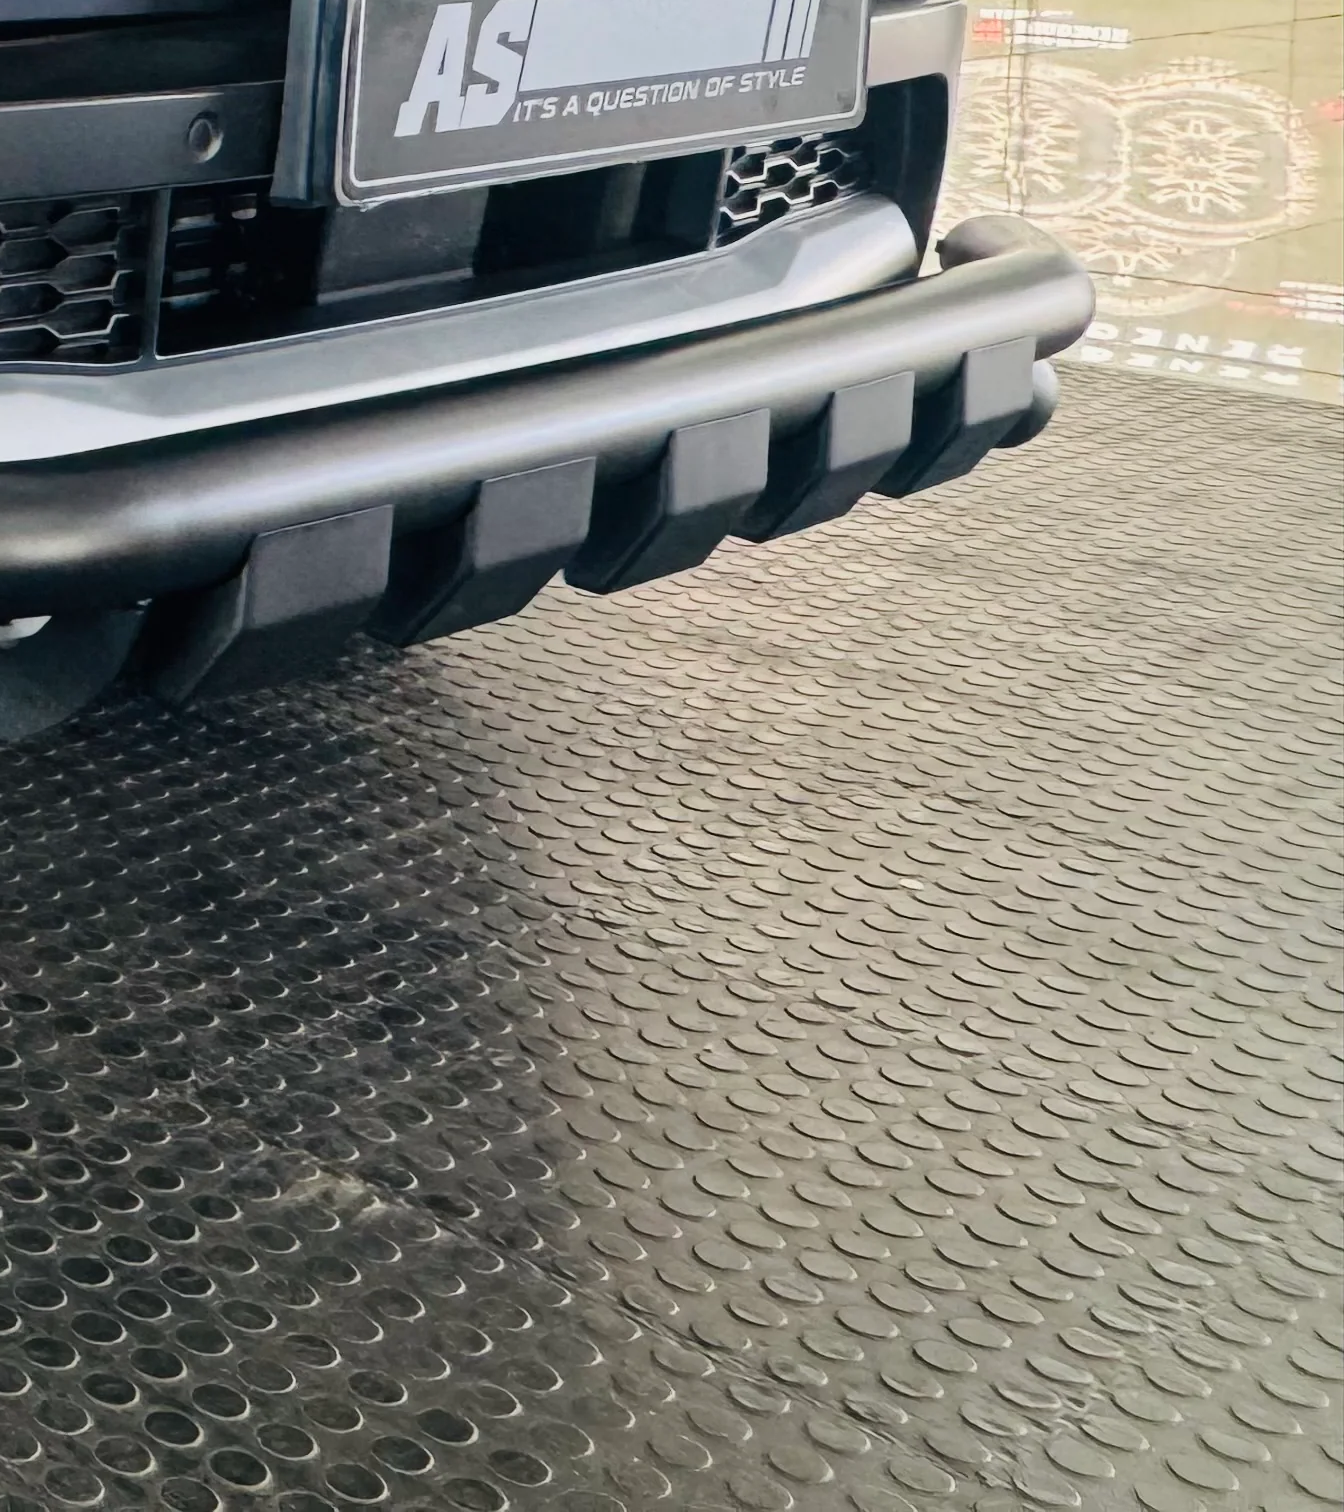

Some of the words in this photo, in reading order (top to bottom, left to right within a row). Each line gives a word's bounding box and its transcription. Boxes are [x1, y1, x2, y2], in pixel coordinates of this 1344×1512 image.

[561, 97, 580, 117] A
[585, 78, 701, 117] QUESTION
[703, 75, 738, 98] OF
[738, 66, 807, 94] STYLE
